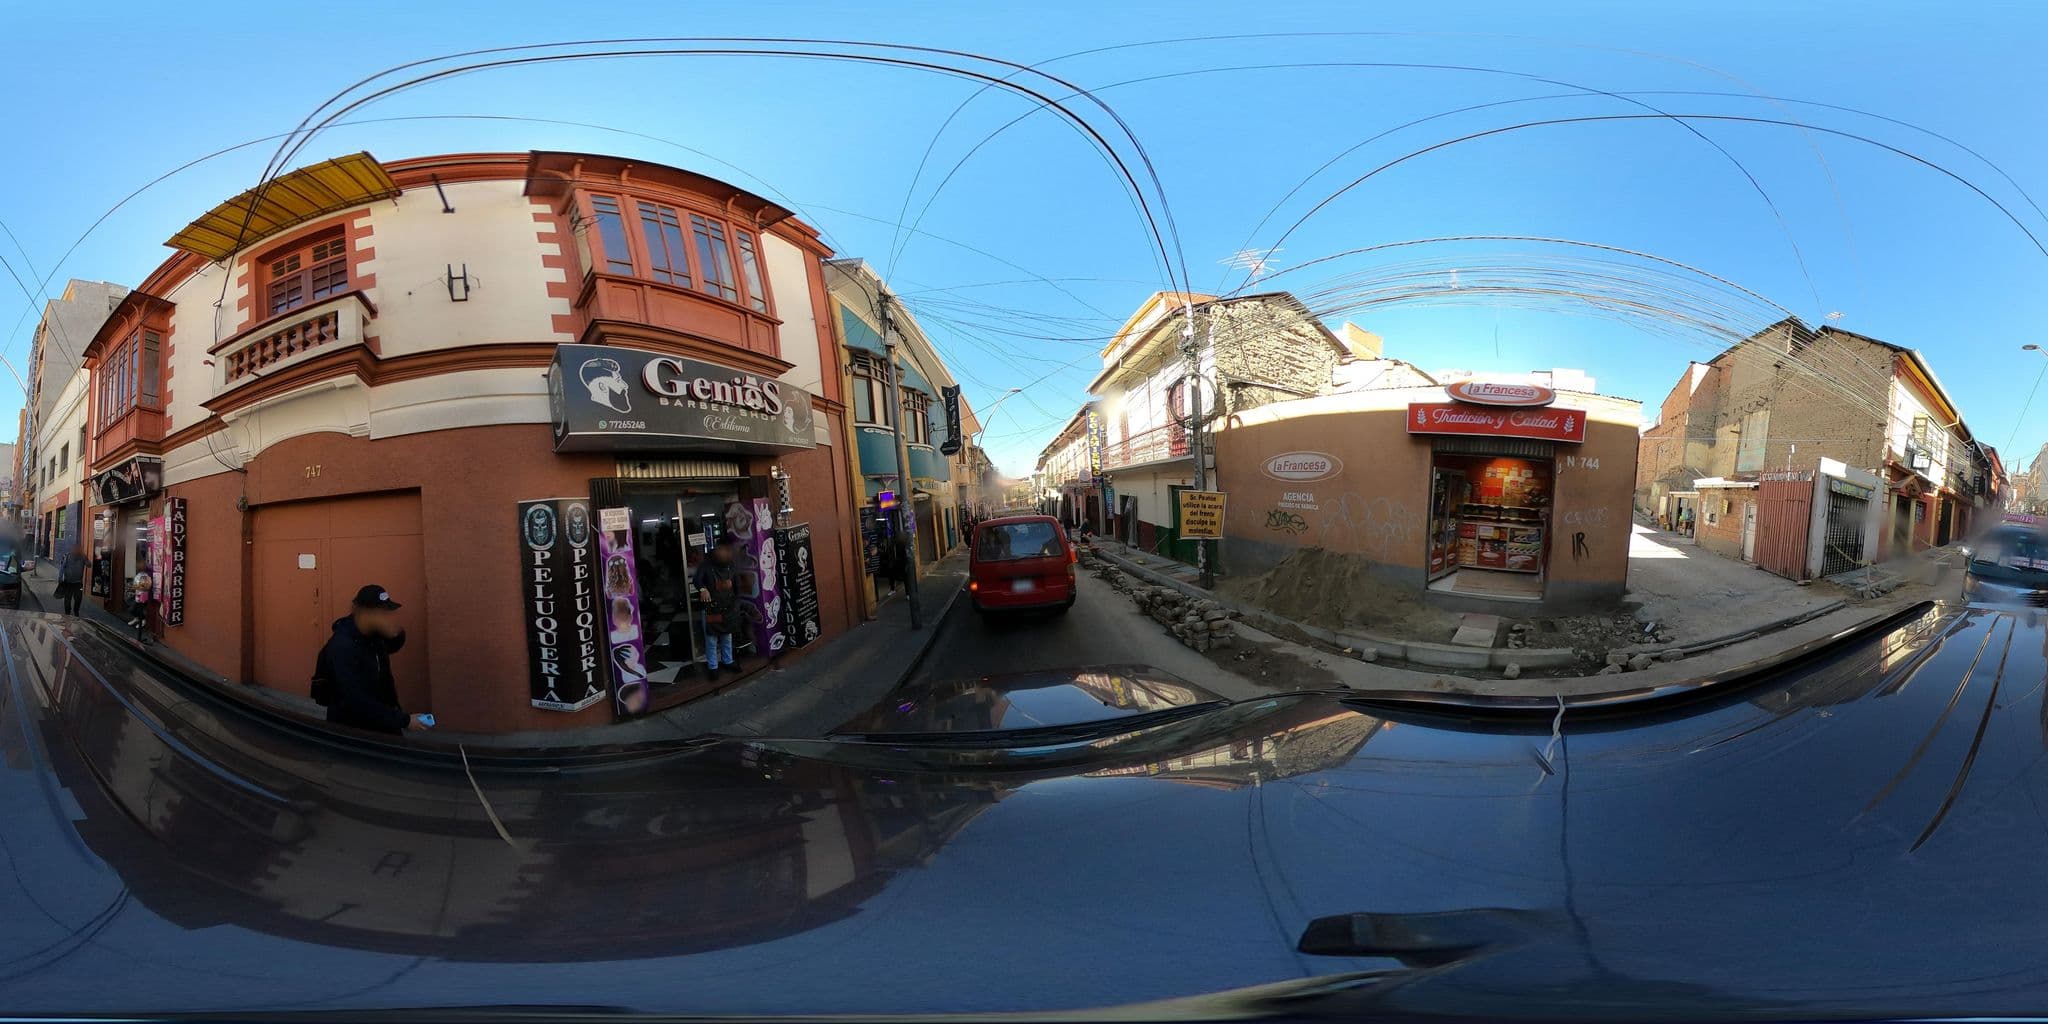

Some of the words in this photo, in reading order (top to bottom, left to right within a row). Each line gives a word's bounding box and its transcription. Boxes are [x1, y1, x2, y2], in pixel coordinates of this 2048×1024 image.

[1483, 383, 1535, 397] Francesa
[659, 397, 730, 413] BARBER
[739, 408, 777, 422] SHOP
[608, 420, 646, 430] 77265248
[1494, 415, 1505, 429] y
[1283, 460, 1327, 471] Francesa
[1581, 457, 1600, 470] 744
[305, 464, 321, 479] 747
[1283, 492, 1314, 502] AGENCIA
[172, 498, 185, 547] LADY
[172, 551, 185, 622] BARBER
[779, 550, 797, 646] PEINADOS
[532, 551, 561, 702] PELUQUERIA
[573, 548, 599, 698] PELUQUERIA
